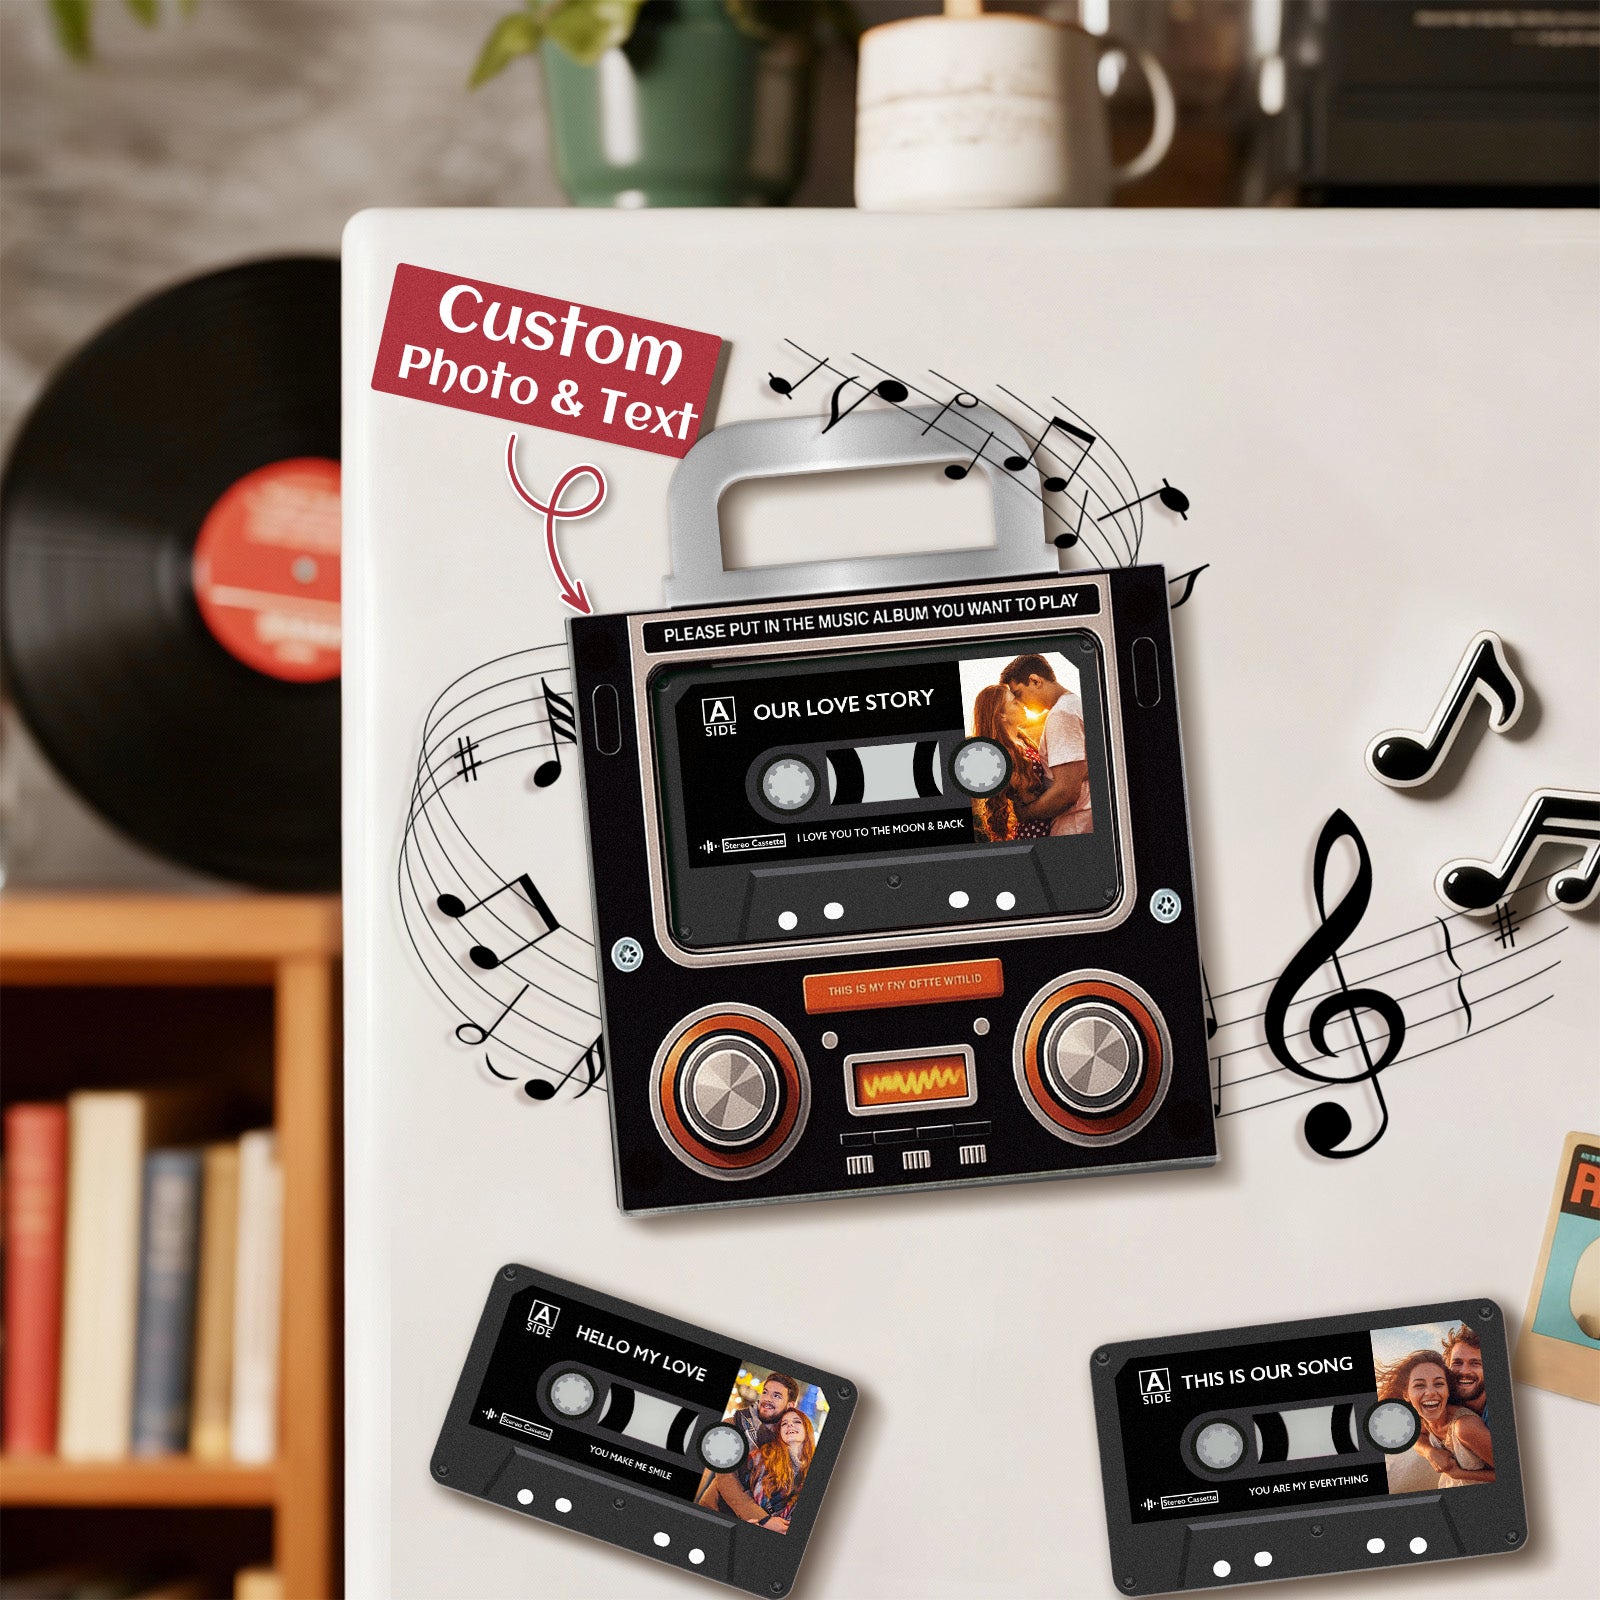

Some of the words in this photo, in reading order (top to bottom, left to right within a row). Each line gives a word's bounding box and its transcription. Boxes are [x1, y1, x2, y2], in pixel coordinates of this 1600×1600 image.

[664, 623, 727, 643] PLEASE
[729, 620, 761, 637] PUT
[764, 618, 780, 634] IN
[782, 615, 815, 632] THE
[818, 610, 870, 629] MUSIC
[873, 605, 929, 625] ALBUM
[932, 602, 965, 618] YOU
[967, 599, 1013, 616] WANT
[1015, 597, 1036, 612] TO
[1039, 592, 1079, 610] PLAY
[709, 700, 730, 723] A
[753, 702, 801, 721] OUR
[806, 695, 860, 717] LOVE
[866, 688, 935, 711] STORY
[705, 724, 737, 737] SIDE
[797, 833, 801, 843] I
[803, 831, 828, 842] LOVE
[829, 829, 852, 840] YOU
[854, 827, 869, 838] TO
[871, 825, 891, 836] THE
[892, 822, 926, 834] MOON
[927, 821, 935, 831] &
[937, 818, 965, 830] BACK
[724, 841, 750, 850] Stereo
[751, 838, 784, 847] Cassette
[828, 985, 853, 996] THIS
[855, 983, 867, 994] IS
[869, 982, 885, 992] MY
[533, 1305, 551, 1325] A
[525, 1321, 553, 1339] SIDE
[576, 1324, 631, 1354] HELLO
[633, 1345, 661, 1365] MY
[662, 1355, 708, 1382] LOVE
[1146, 1370, 1165, 1392] A
[1181, 1371, 1224, 1390] THIS
[1229, 1368, 1246, 1385] IS
[1250, 1363, 1293, 1382] OUR
[1297, 1356, 1354, 1376] SONG
[1142, 1392, 1172, 1405] SIDE
[590, 1444, 609, 1458] YOU
[609, 1452, 634, 1467] MAKE
[634, 1460, 648, 1472] ME
[647, 1465, 673, 1481] SMILE
[1248, 1485, 1270, 1496] YOU
[1272, 1483, 1291, 1494] ARE
[1292, 1481, 1307, 1492] MY
[1309, 1474, 1369, 1489] EVERYTHING
[1162, 1498, 1186, 1507] Stereo
